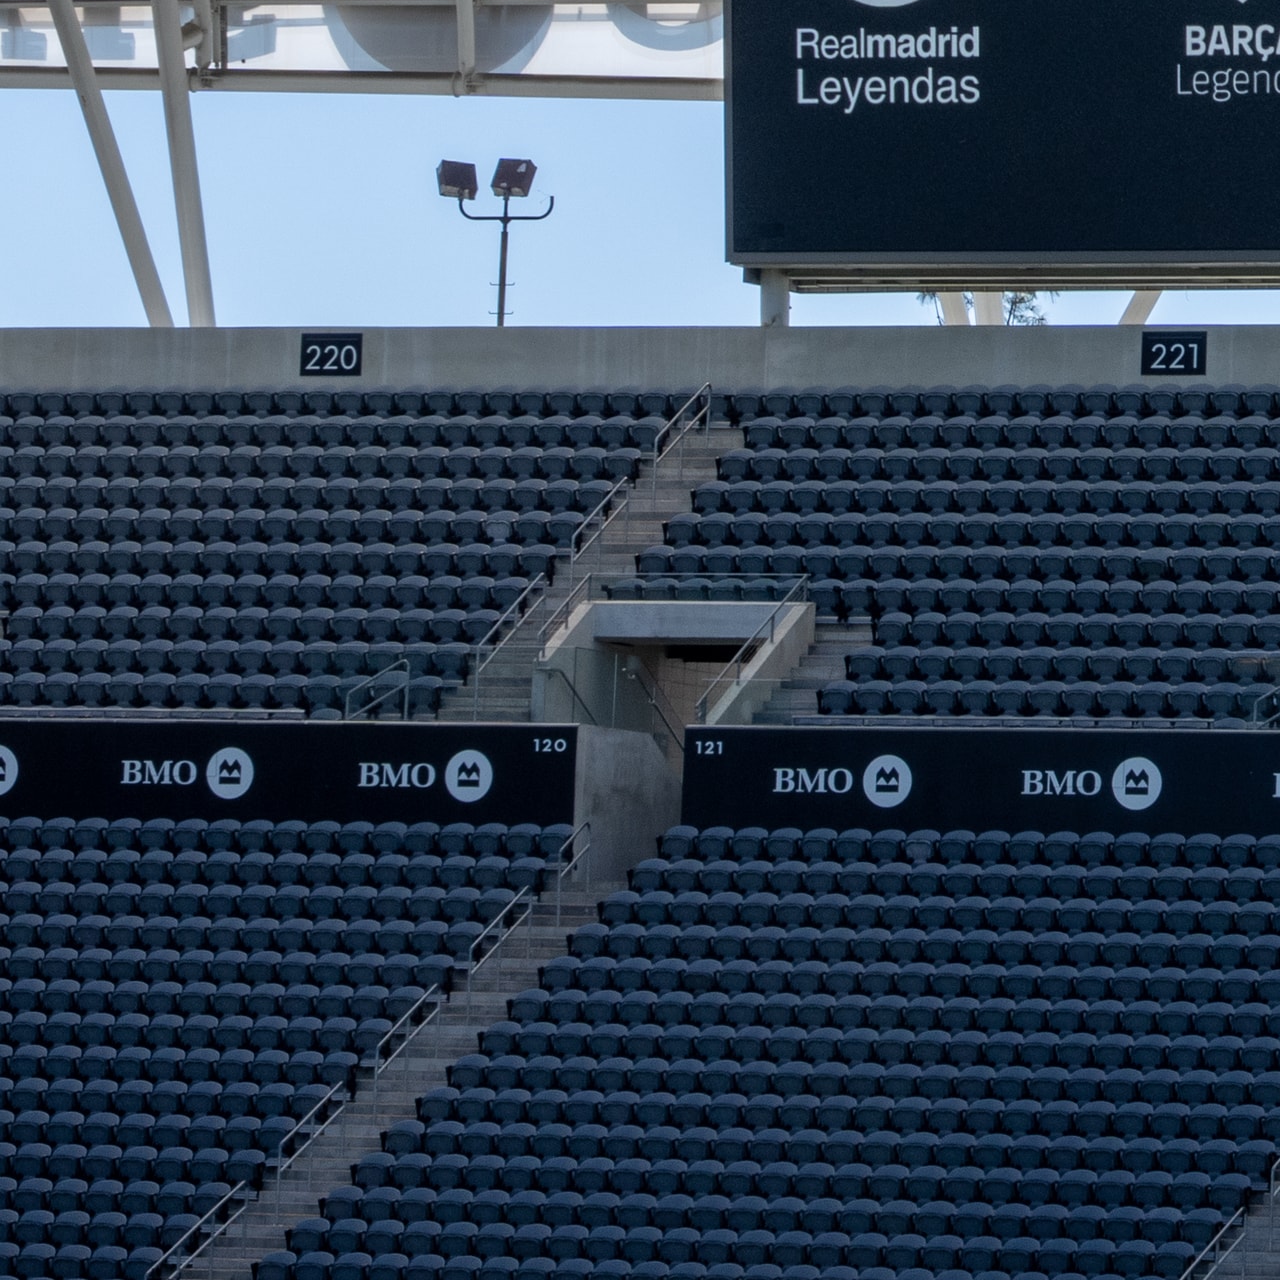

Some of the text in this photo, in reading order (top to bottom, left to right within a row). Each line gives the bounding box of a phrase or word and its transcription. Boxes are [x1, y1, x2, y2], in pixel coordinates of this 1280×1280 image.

[797, 26, 979, 59] Realmadrid
[797, 67, 980, 113] Leyendas
[305, 345, 356, 369] 220
[1151, 344, 1197, 368] 221
[534, 739, 566, 752] 120
[696, 741, 722, 754] 121
[121, 760, 197, 785] BMO
[358, 763, 435, 787] BMO
[773, 768, 853, 793] BMO
[1021, 770, 1102, 795] BMO
